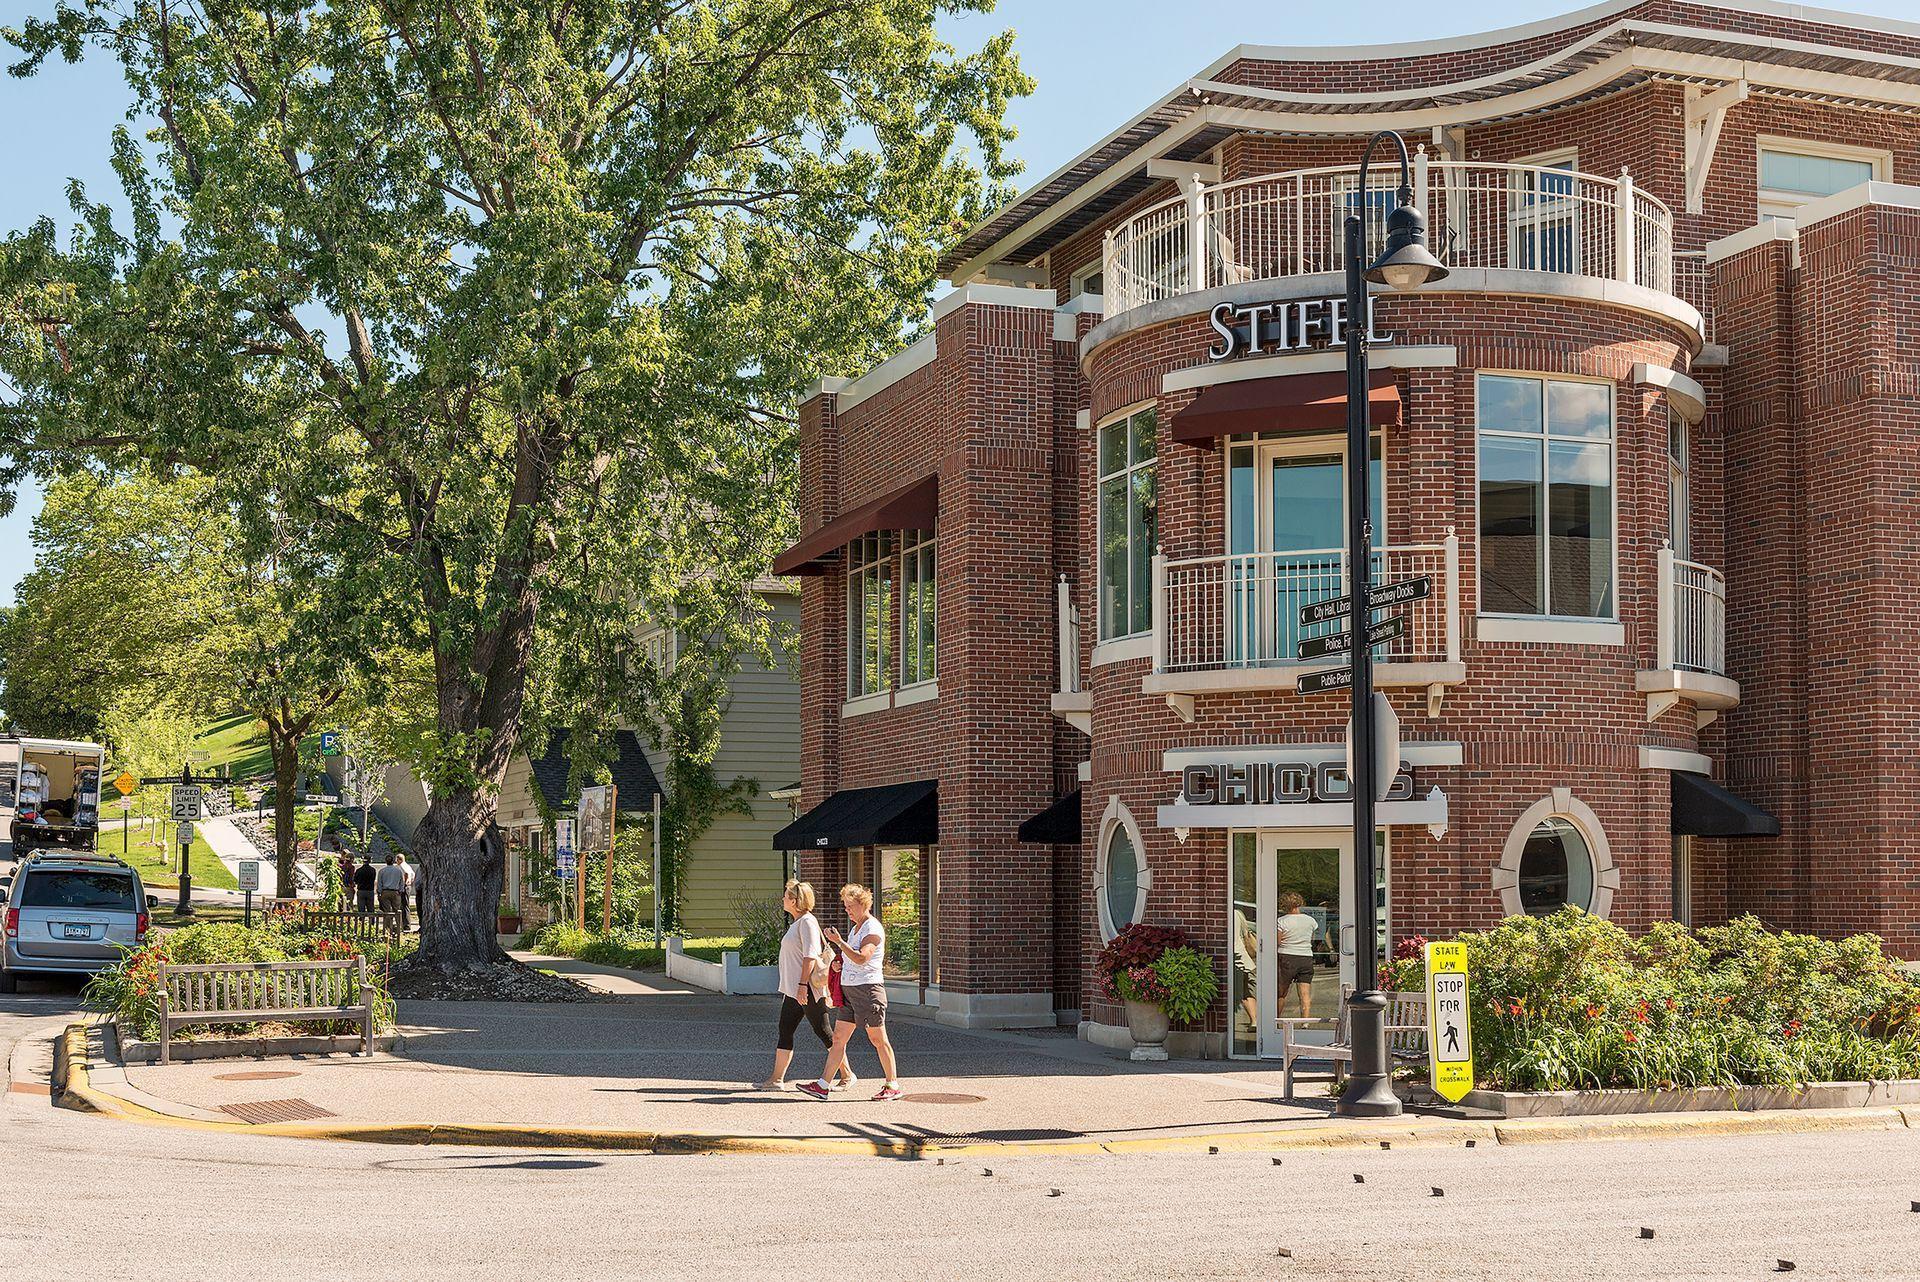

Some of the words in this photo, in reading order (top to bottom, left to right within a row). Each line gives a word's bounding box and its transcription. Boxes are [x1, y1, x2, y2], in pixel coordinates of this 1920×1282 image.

[1209, 296, 1394, 361] STIFEL
[1370, 590, 1396, 604] Broadway
[1397, 584, 1414, 598] Docks
[1314, 606, 1324, 620] City
[1337, 601, 1351, 613] Libra
[1321, 674, 1336, 686] Public
[175, 803, 198, 817] 25
[1435, 946, 1460, 956] STATE
[1439, 961, 1456, 970] LAW
[1437, 980, 1463, 993] STOP
[1439, 1000, 1460, 1012] FOR
